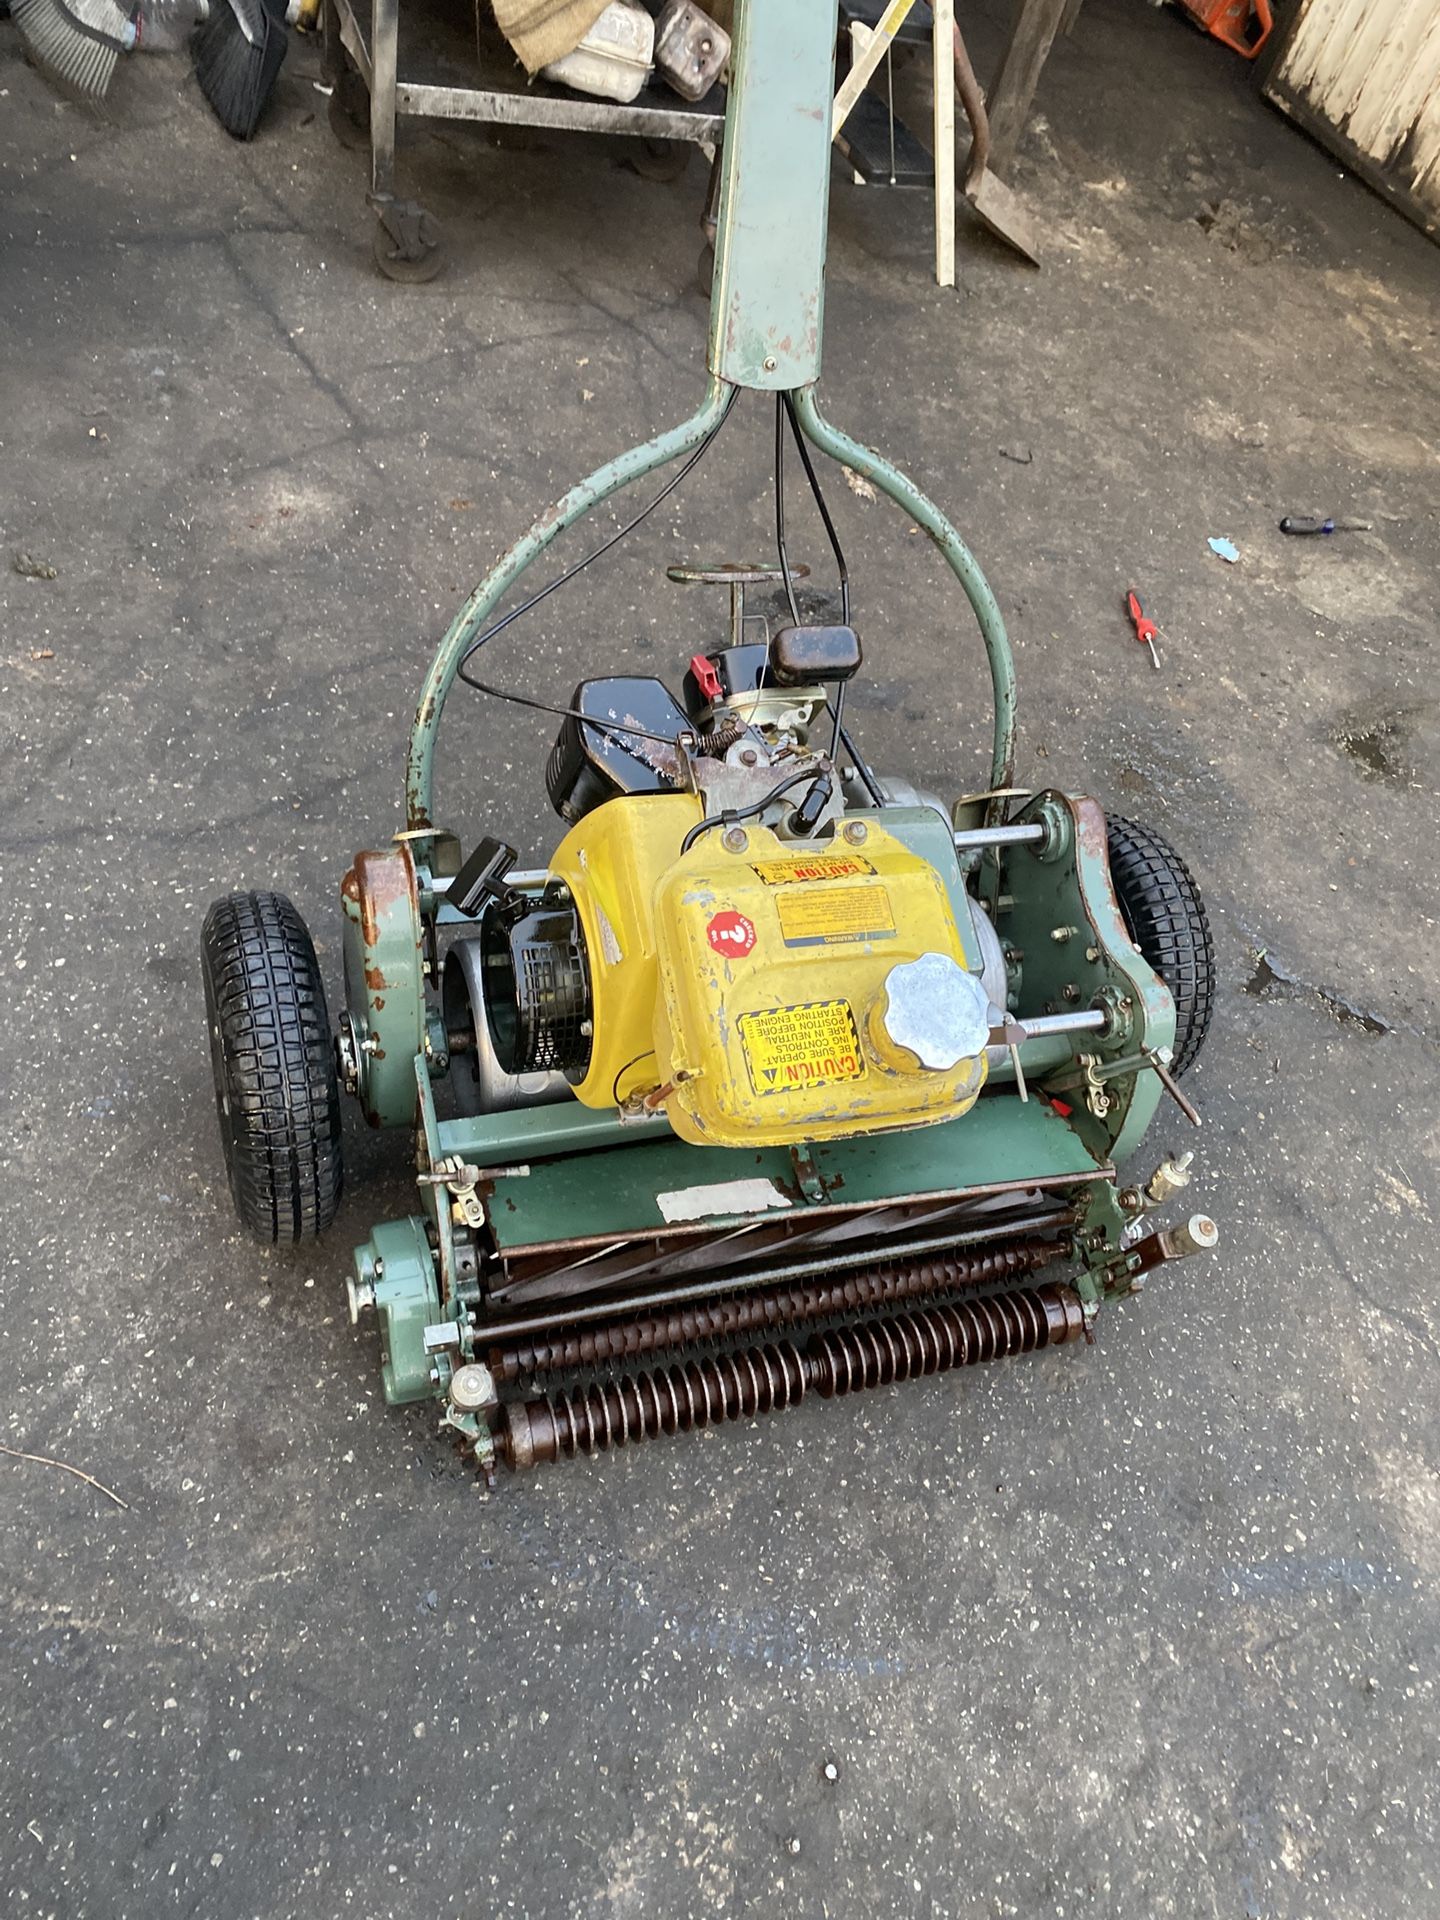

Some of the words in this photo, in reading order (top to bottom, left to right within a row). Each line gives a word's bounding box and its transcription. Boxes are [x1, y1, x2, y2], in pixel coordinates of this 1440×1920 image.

[794, 864, 859, 878] CAUTION
[739, 918, 754, 948] CHECKED
[751, 1015, 790, 1027] ENGINE.
[794, 1008, 842, 1022] STARTING
[799, 1017, 844, 1028] POSITION
[757, 1024, 795, 1037] BEFORE
[815, 1030, 824, 1038] IN
[828, 1026, 846, 1035] ARE
[765, 1031, 810, 1044] NEUTRAL
[832, 1035, 849, 1045] ING
[776, 1038, 829, 1053] CONTROLS
[838, 1044, 851, 1053] BE
[762, 1052, 806, 1065] OPERAT-
[809, 1048, 835, 1058] SURE
[786, 1056, 855, 1081] CAUTION
